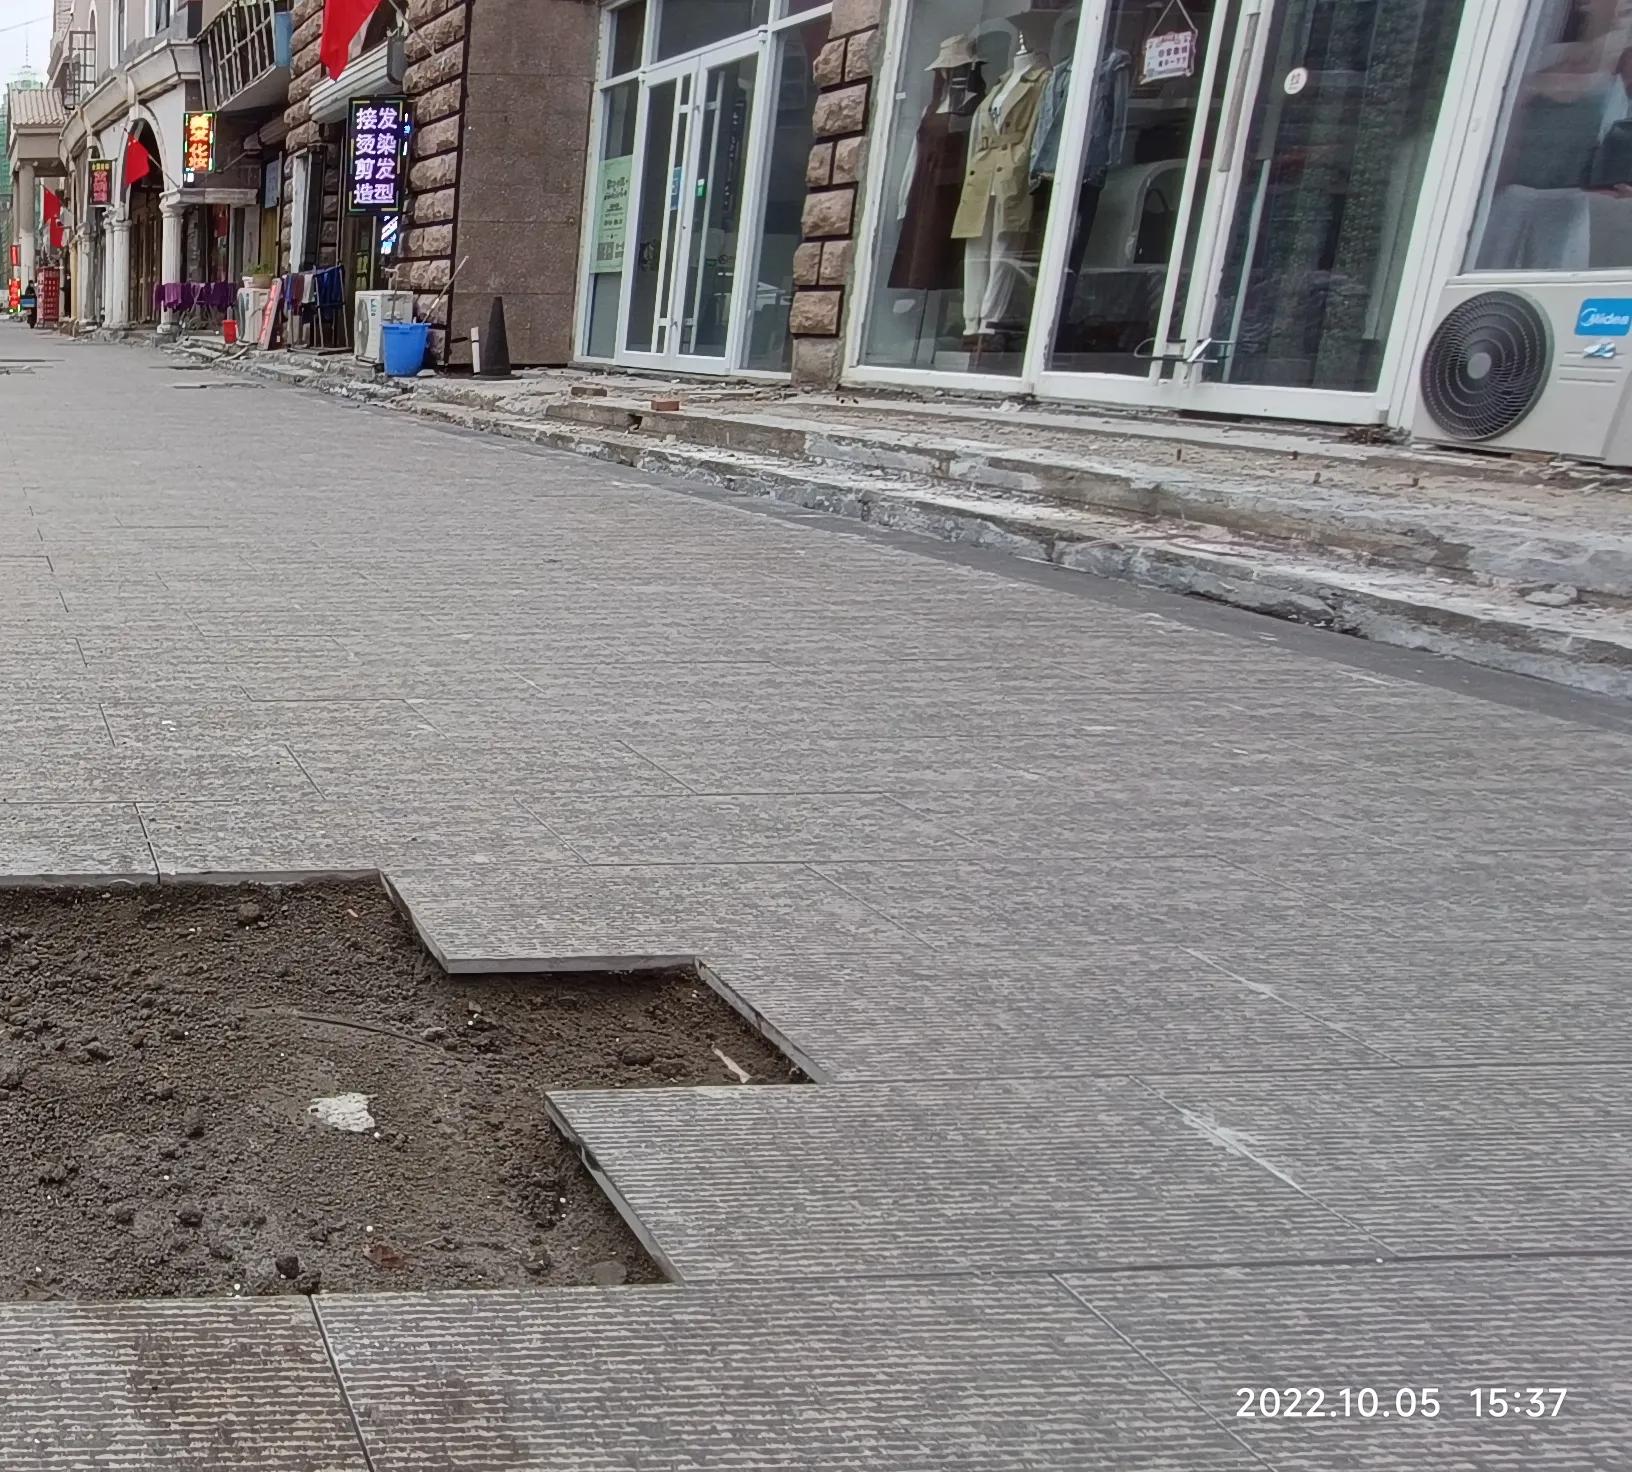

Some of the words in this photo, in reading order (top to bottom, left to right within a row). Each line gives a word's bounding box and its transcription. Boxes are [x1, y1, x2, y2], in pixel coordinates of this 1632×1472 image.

[356, 107, 398, 130] 接发
[355, 133, 397, 155] 烫染
[354, 158, 395, 180] 剪发
[353, 183, 395, 204] 造型
